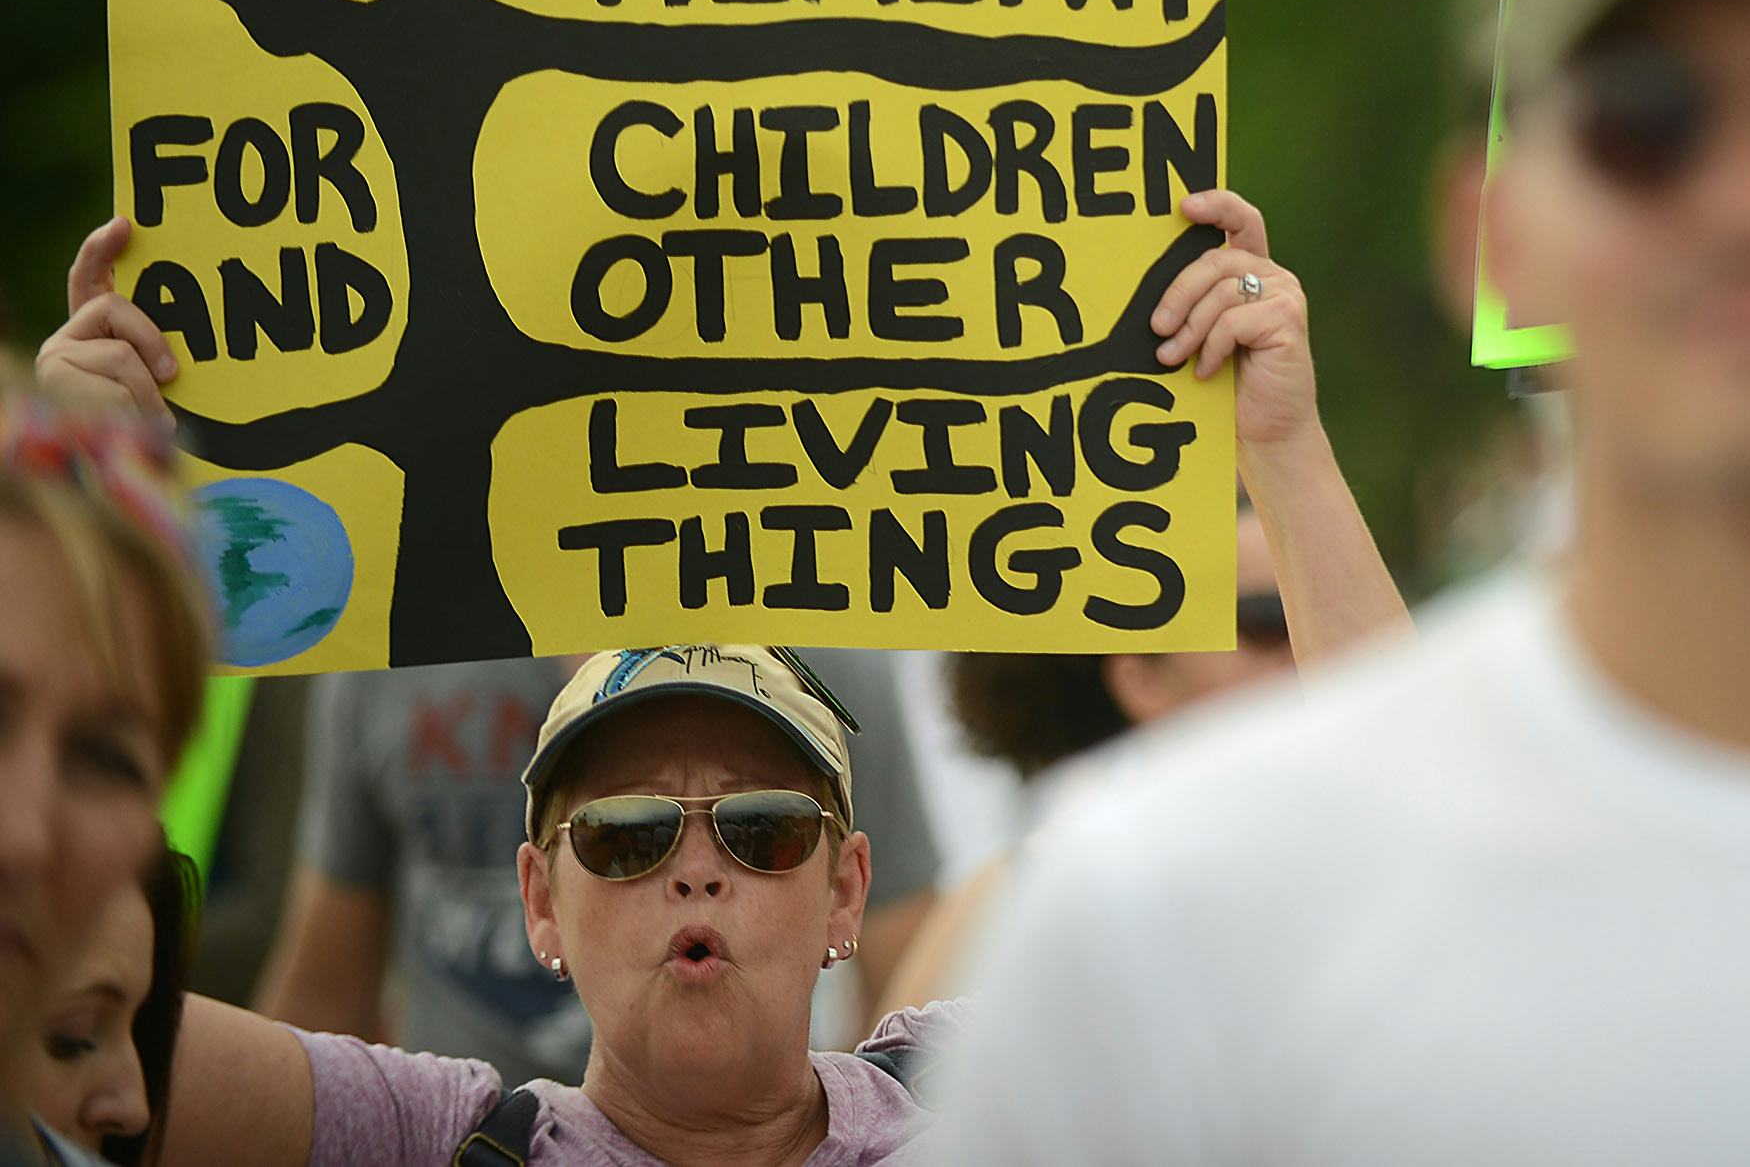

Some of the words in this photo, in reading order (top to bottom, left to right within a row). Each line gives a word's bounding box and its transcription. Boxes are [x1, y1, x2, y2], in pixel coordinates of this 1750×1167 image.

[130, 102, 378, 234] FOR
[589, 93, 1217, 223] CHILDREN
[131, 242, 393, 363] AND
[570, 229, 1083, 348] OTHER
[588, 378, 1197, 498] LIVING
[558, 501, 1186, 630] THINGS
